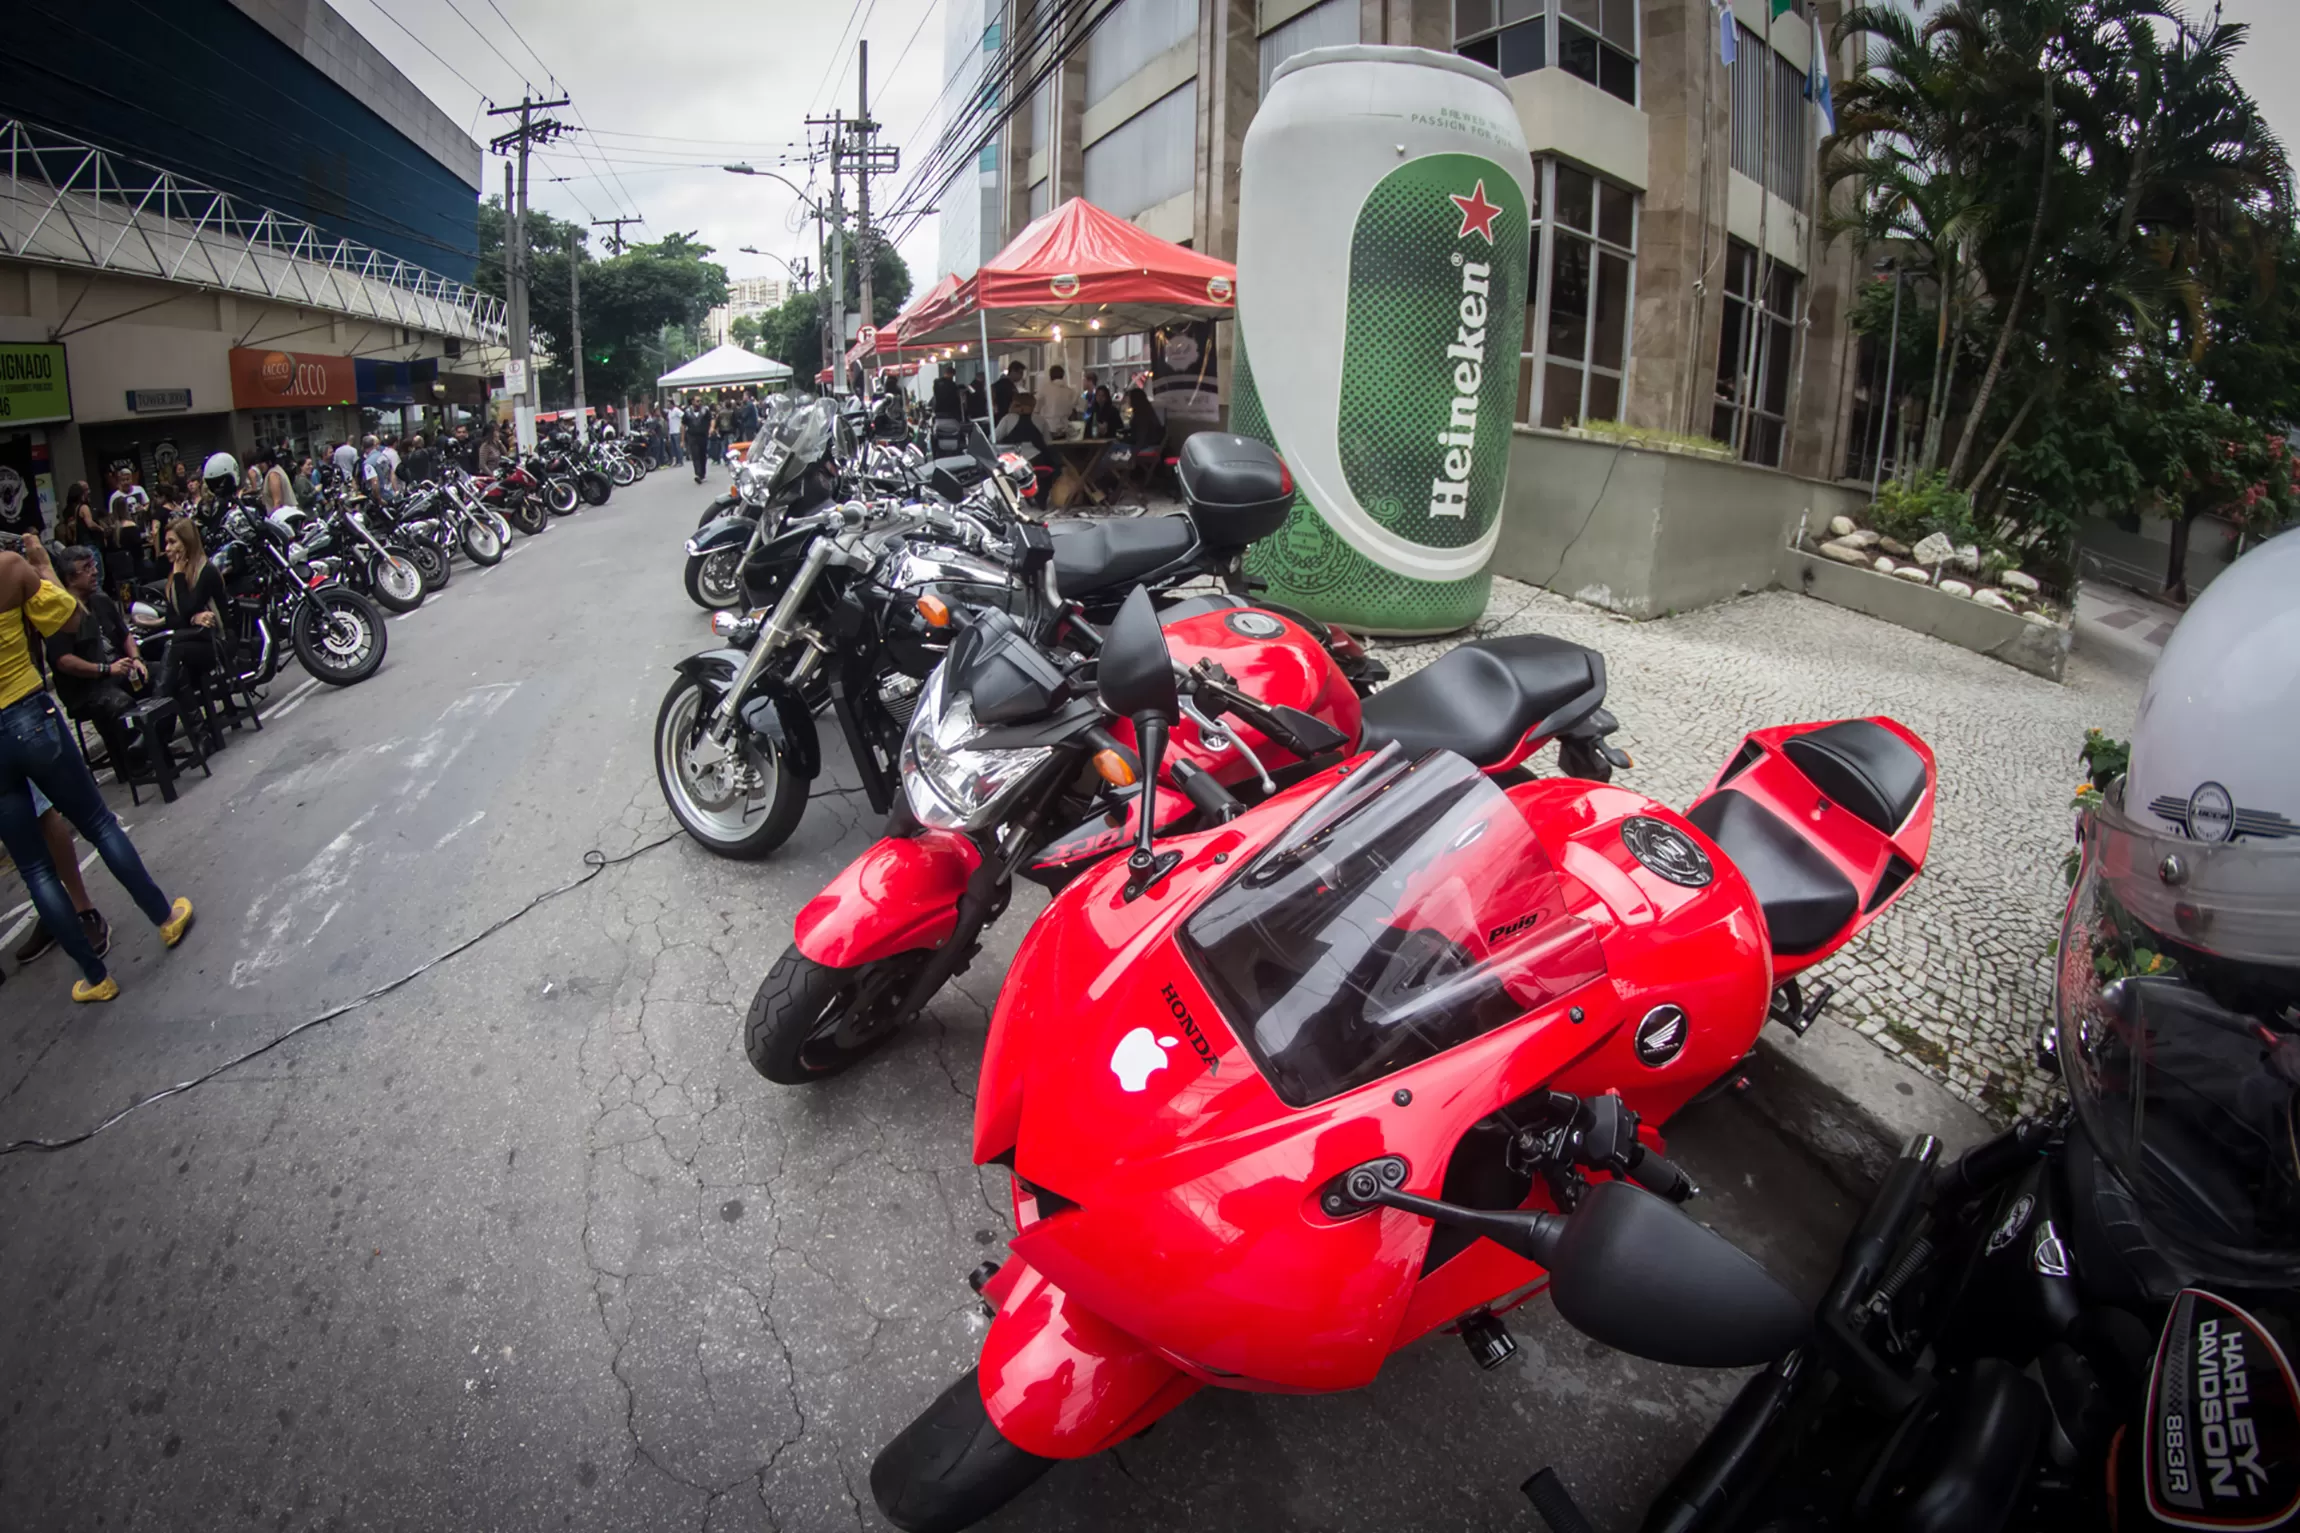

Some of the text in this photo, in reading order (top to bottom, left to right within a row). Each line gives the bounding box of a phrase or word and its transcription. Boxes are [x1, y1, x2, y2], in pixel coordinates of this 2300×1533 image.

[1411, 113, 1466, 132] PASSION
[1470, 125, 1491, 140] FOR
[1441, 107, 1485, 126] BREWED
[0, 352, 53, 381] IGNADO
[1429, 260, 1491, 520] Heineken
[1489, 913, 1538, 943] Puig
[1161, 982, 1220, 1078] HONDA
[2198, 1319, 2240, 1498] DAVIDSON
[2166, 1414, 2189, 1493] 883R
